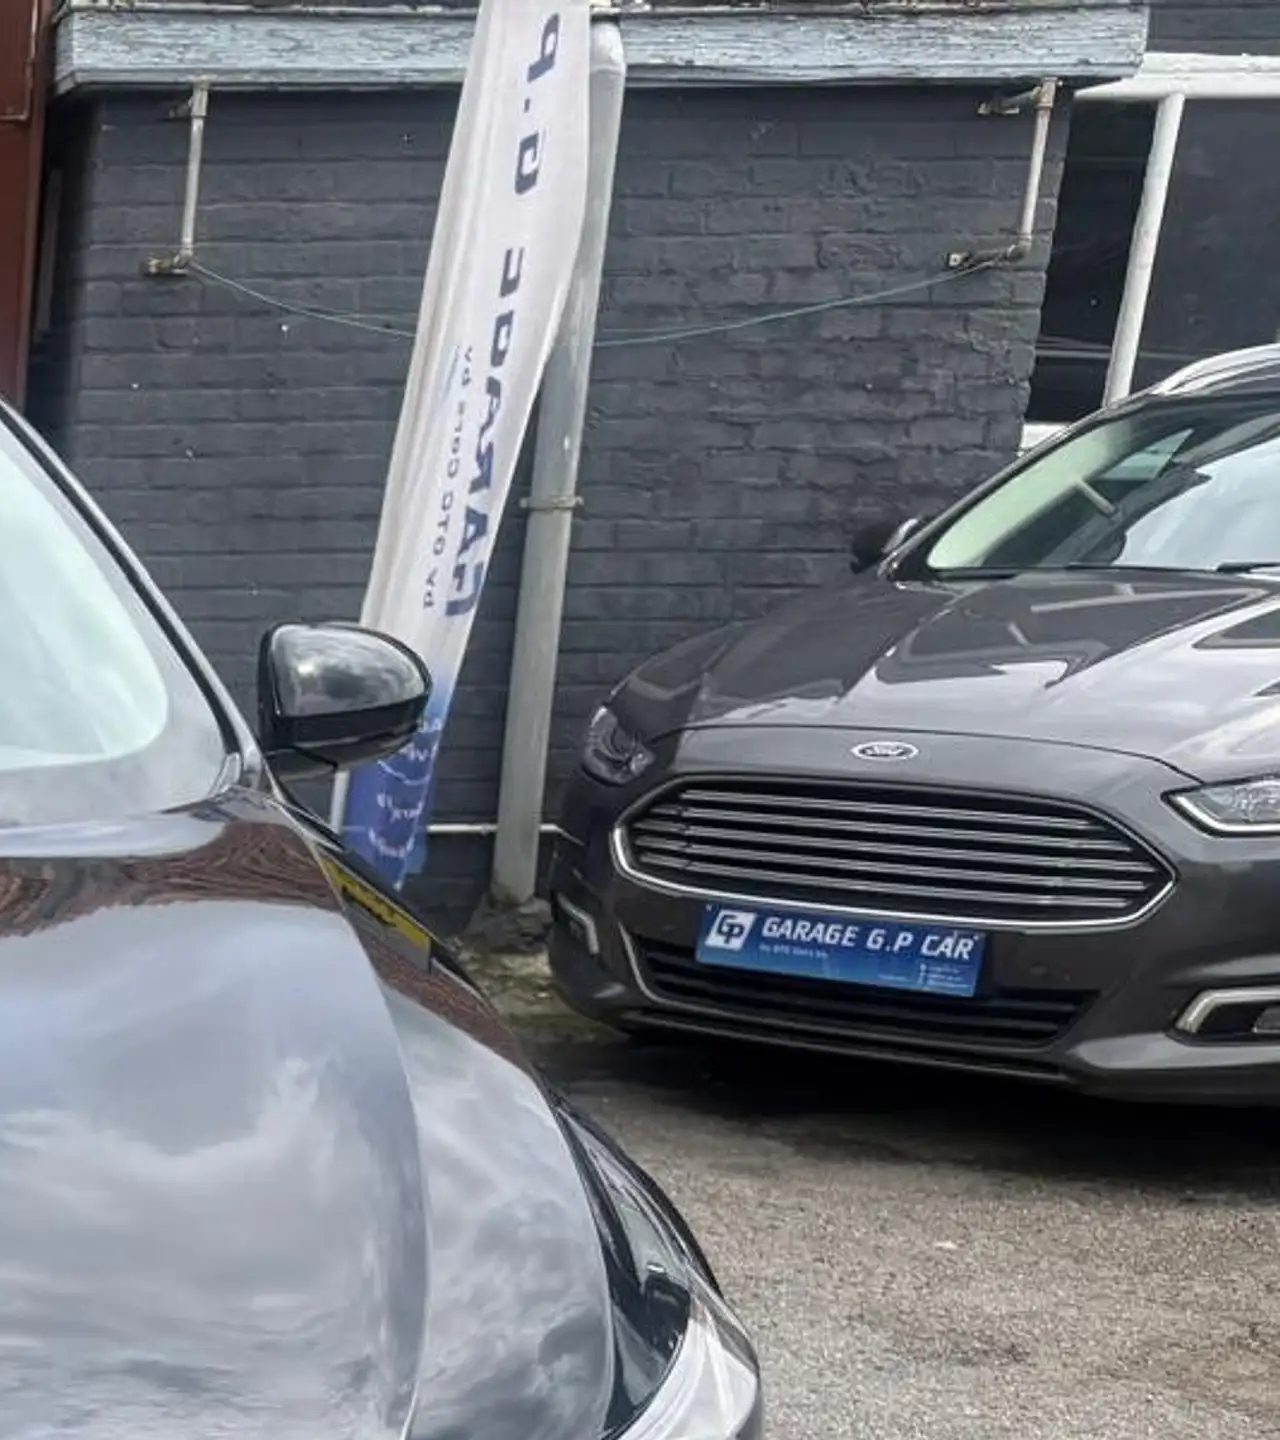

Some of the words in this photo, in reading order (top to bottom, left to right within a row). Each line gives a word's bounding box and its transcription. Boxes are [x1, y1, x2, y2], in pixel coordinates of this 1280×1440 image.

[761, 916, 859, 948] GARAGE
[866, 928, 913, 954] G.P
[920, 934, 974, 961] CAR
